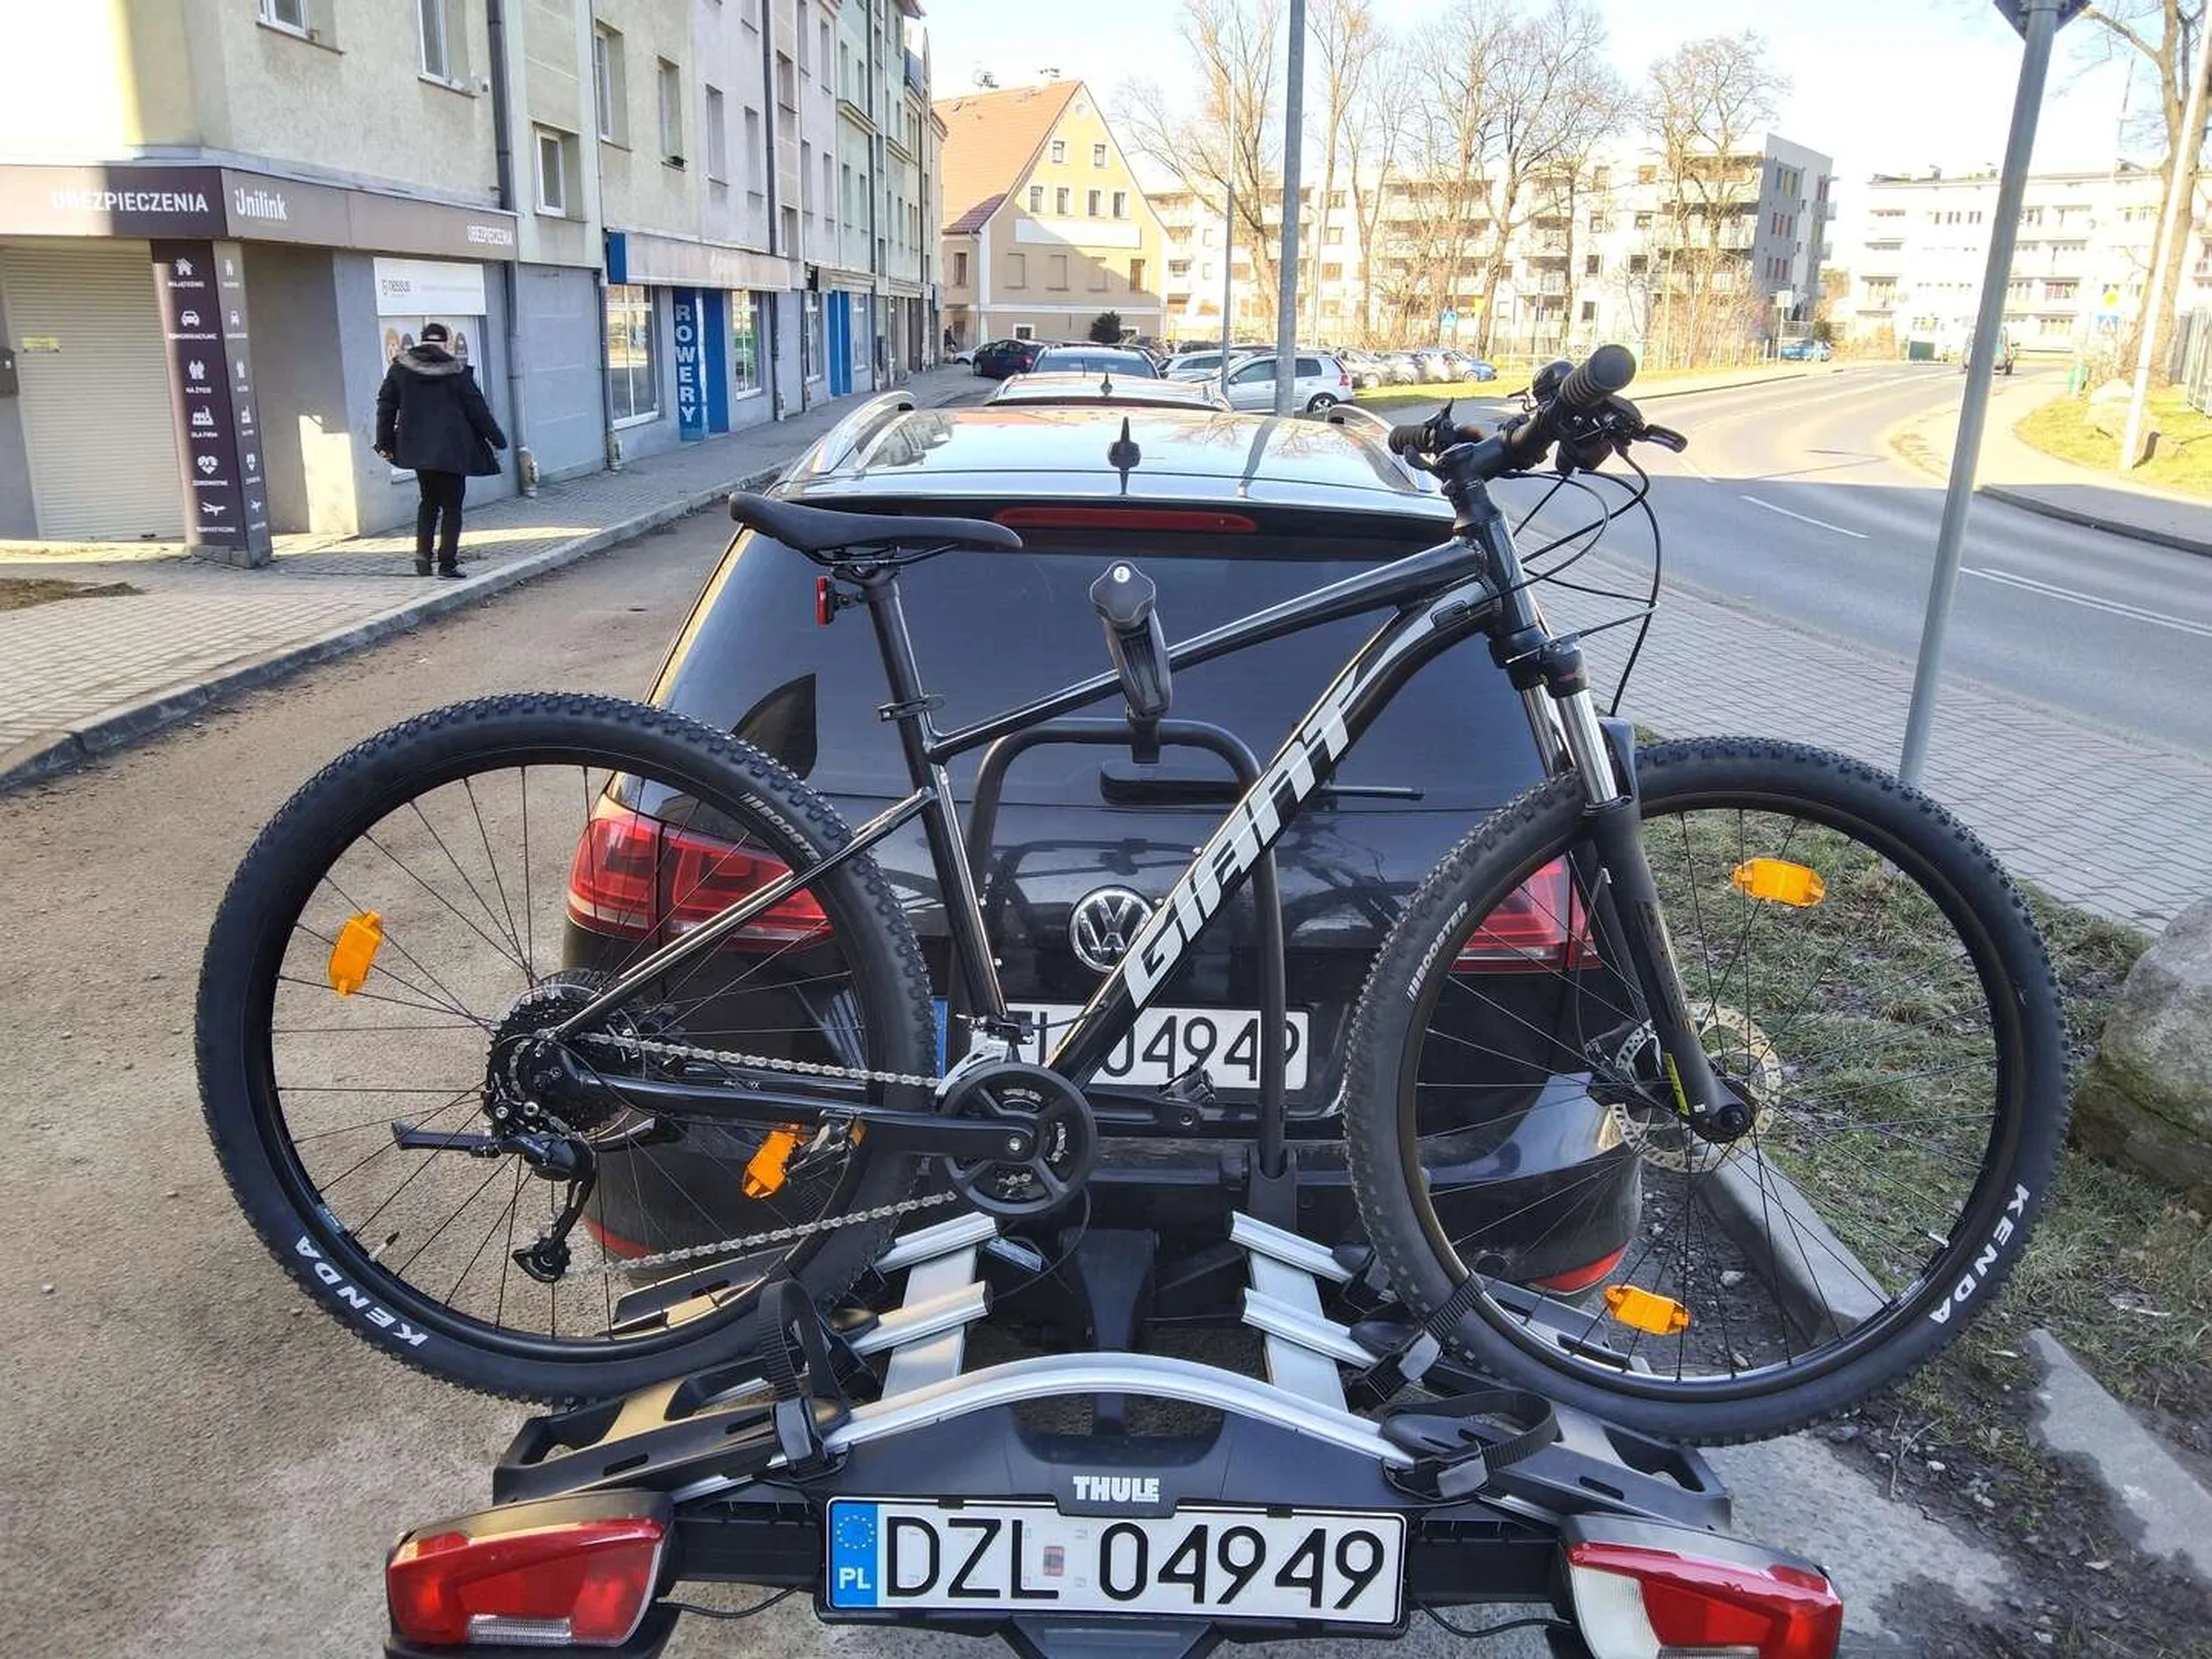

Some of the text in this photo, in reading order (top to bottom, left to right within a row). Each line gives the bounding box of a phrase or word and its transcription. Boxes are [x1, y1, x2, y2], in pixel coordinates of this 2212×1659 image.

[234, 188, 287, 220] Unilink
[675, 304, 696, 423] ROWERY
[758, 806, 821, 864] BOOSTE
[1124, 664, 1360, 1009] GIANT
[296, 1235, 428, 1347] KENDA
[1929, 1183, 2030, 1324] KENDA
[1072, 1475, 1160, 1503] THULE
[839, 1567, 872, 1589] PL
[887, 1516, 1385, 1609] DZL 04949
